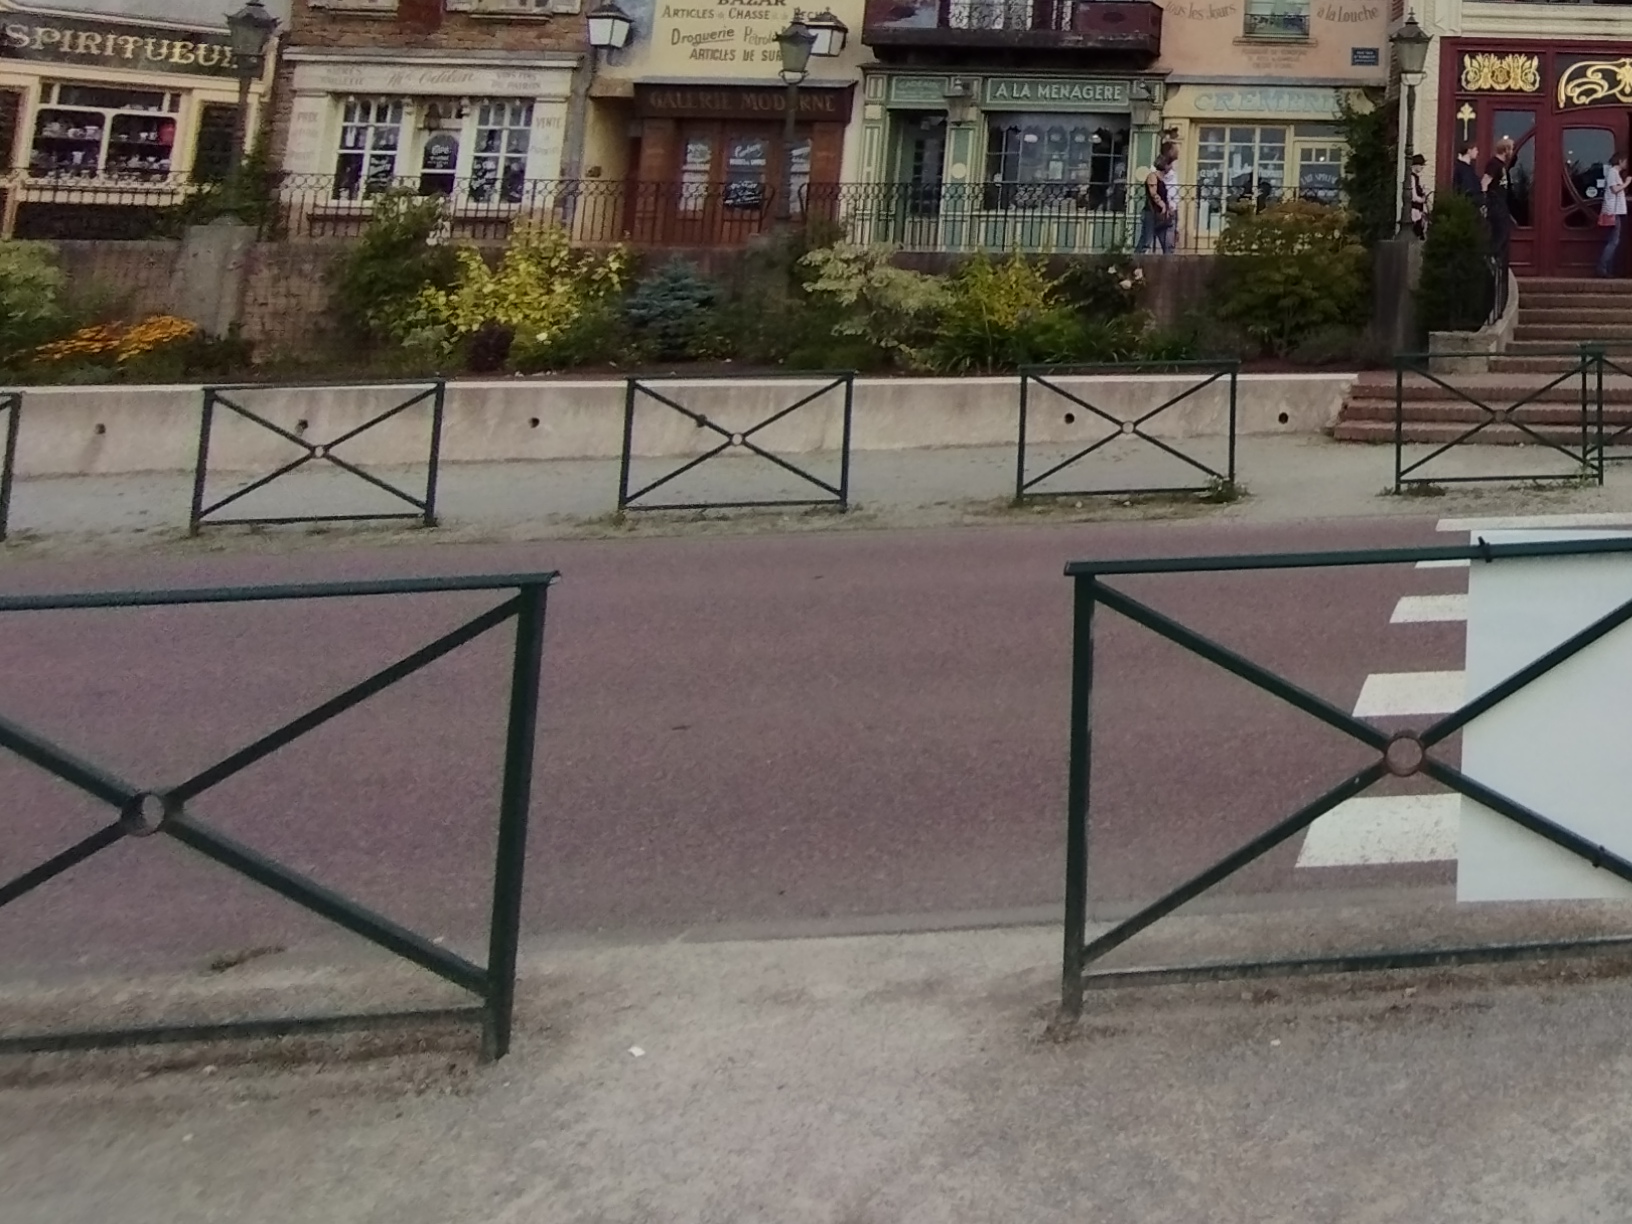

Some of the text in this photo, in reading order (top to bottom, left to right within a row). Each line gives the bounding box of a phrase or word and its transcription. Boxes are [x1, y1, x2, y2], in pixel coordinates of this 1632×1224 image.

[1188, 2, 1205, 21] les
[1325, 4, 1336, 22] la
[671, 27, 735, 47] Droguerie
[690, 48, 736, 62] ARTICLES
[742, 48, 755, 62] DE
[996, 82, 1123, 101] A LA MENAGERE
[650, 91, 837, 112] GALERIE MODRNE
